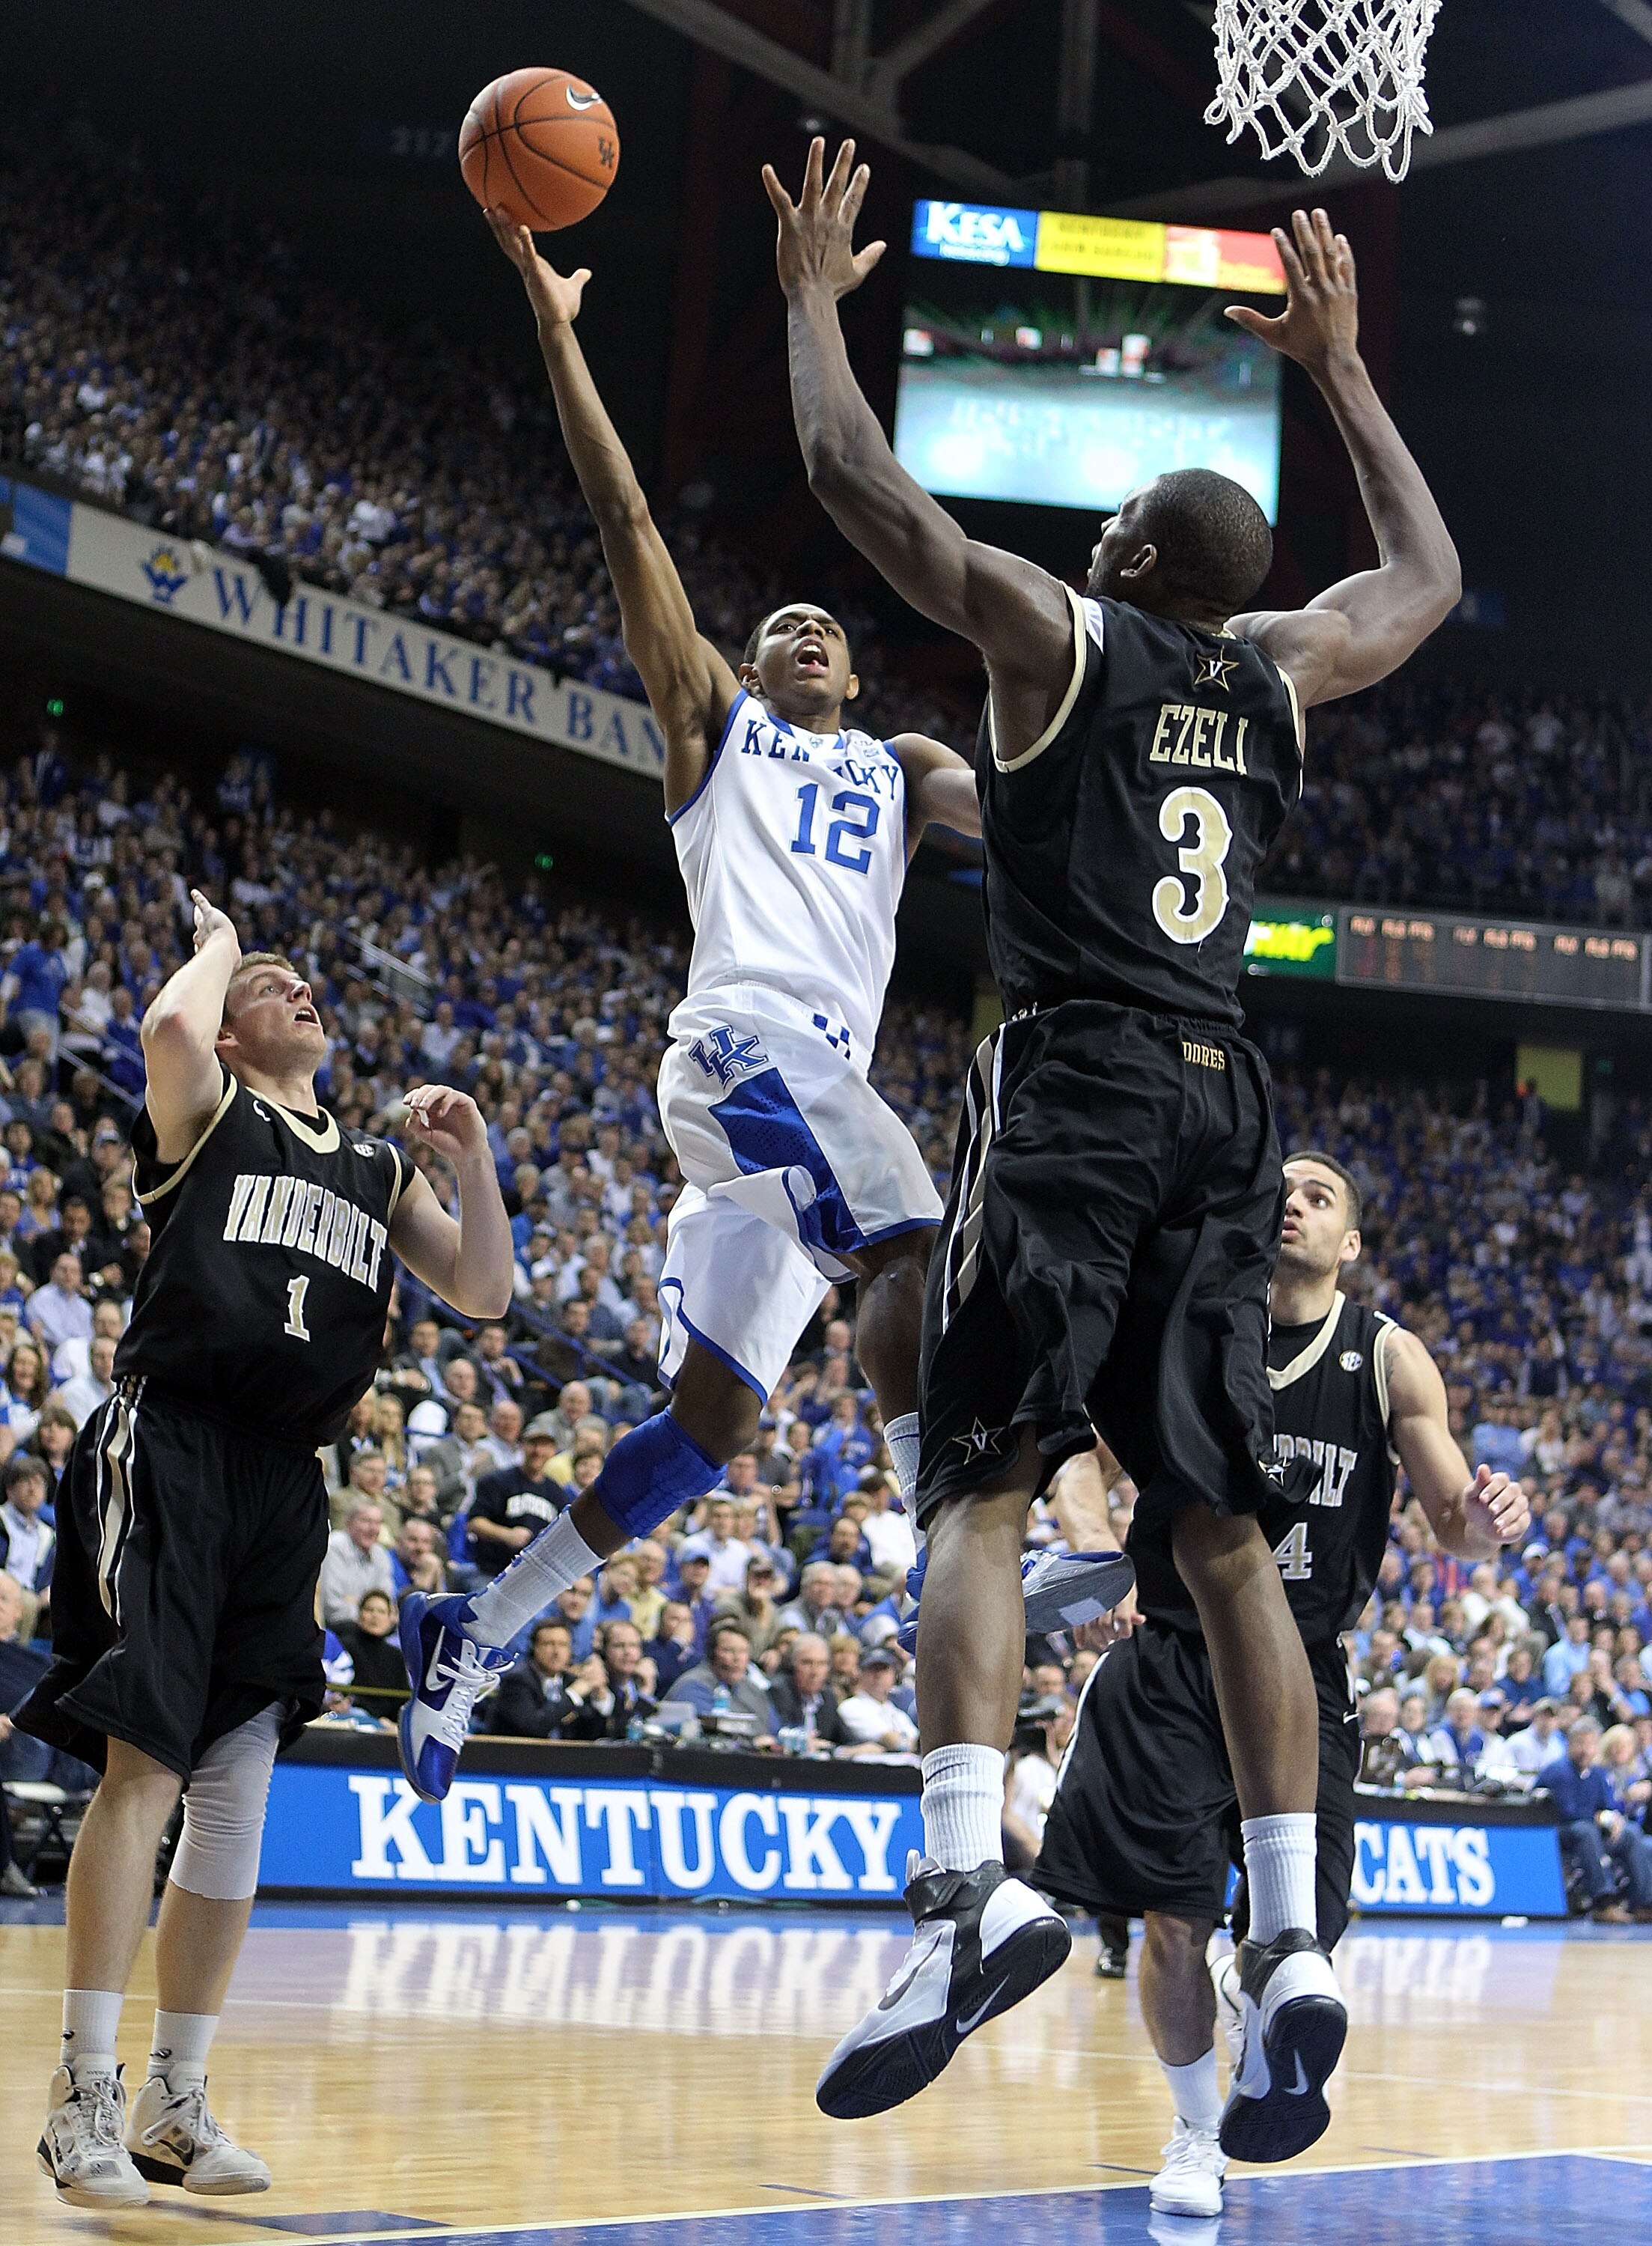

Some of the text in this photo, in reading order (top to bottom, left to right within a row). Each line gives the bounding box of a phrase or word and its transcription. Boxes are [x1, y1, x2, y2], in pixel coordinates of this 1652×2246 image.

[213, 567, 537, 725] WHITAKER
[1149, 704, 1249, 776] EZELI
[790, 782, 881, 877] 12
[1152, 786, 1233, 944] 3
[689, 1024, 769, 1089] UK
[1181, 1041, 1225, 1071] DORES
[223, 1175, 388, 1293] VANDERBILT
[284, 1274, 311, 1342] 1
[1273, 1522, 1313, 1580] 4
[349, 1774, 902, 1892] KENTUCKY
[1350, 1821, 1496, 1907] CATS
